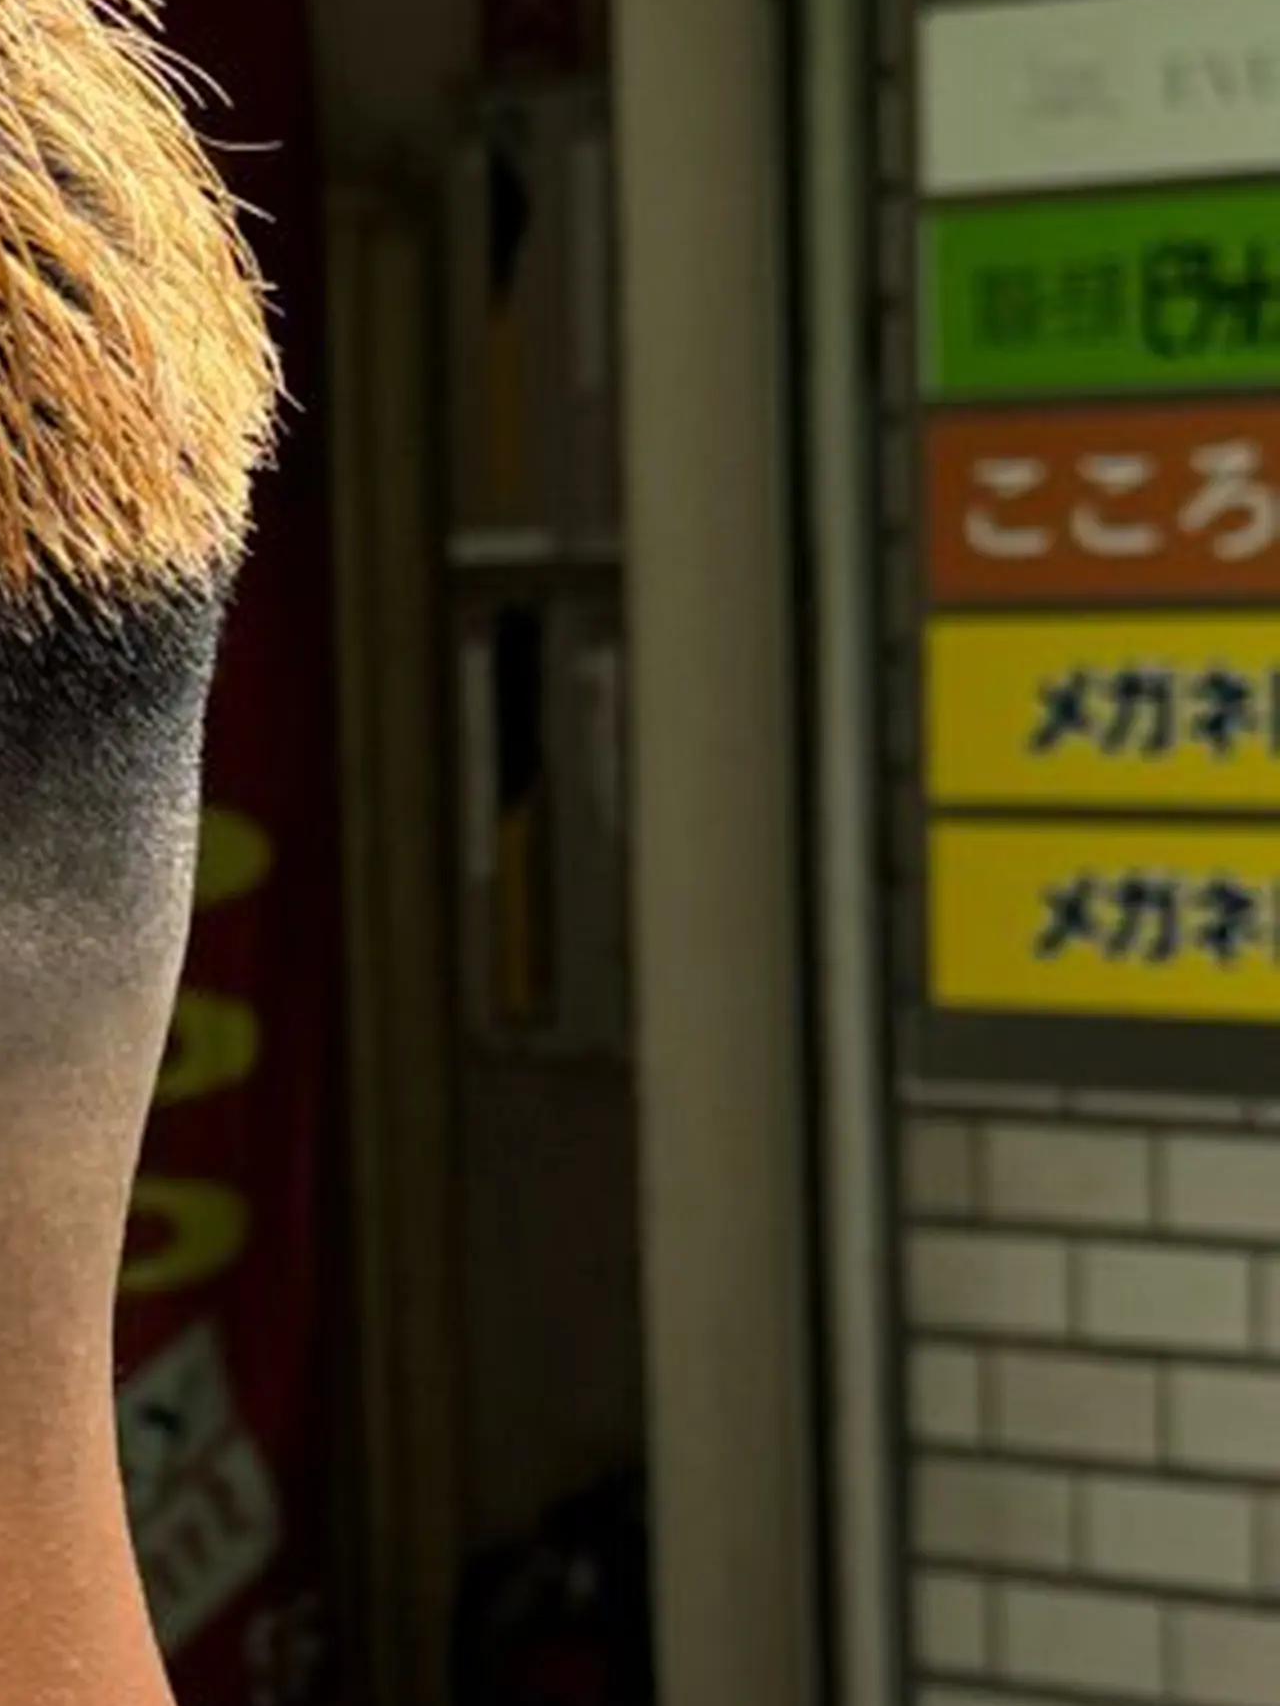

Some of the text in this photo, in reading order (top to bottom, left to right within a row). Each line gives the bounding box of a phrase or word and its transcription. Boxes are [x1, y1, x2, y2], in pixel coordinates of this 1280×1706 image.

[963, 436, 1280, 562] こころ
[1028, 666, 1280, 757] メガネ
[1034, 869, 1280, 964] メガネ
